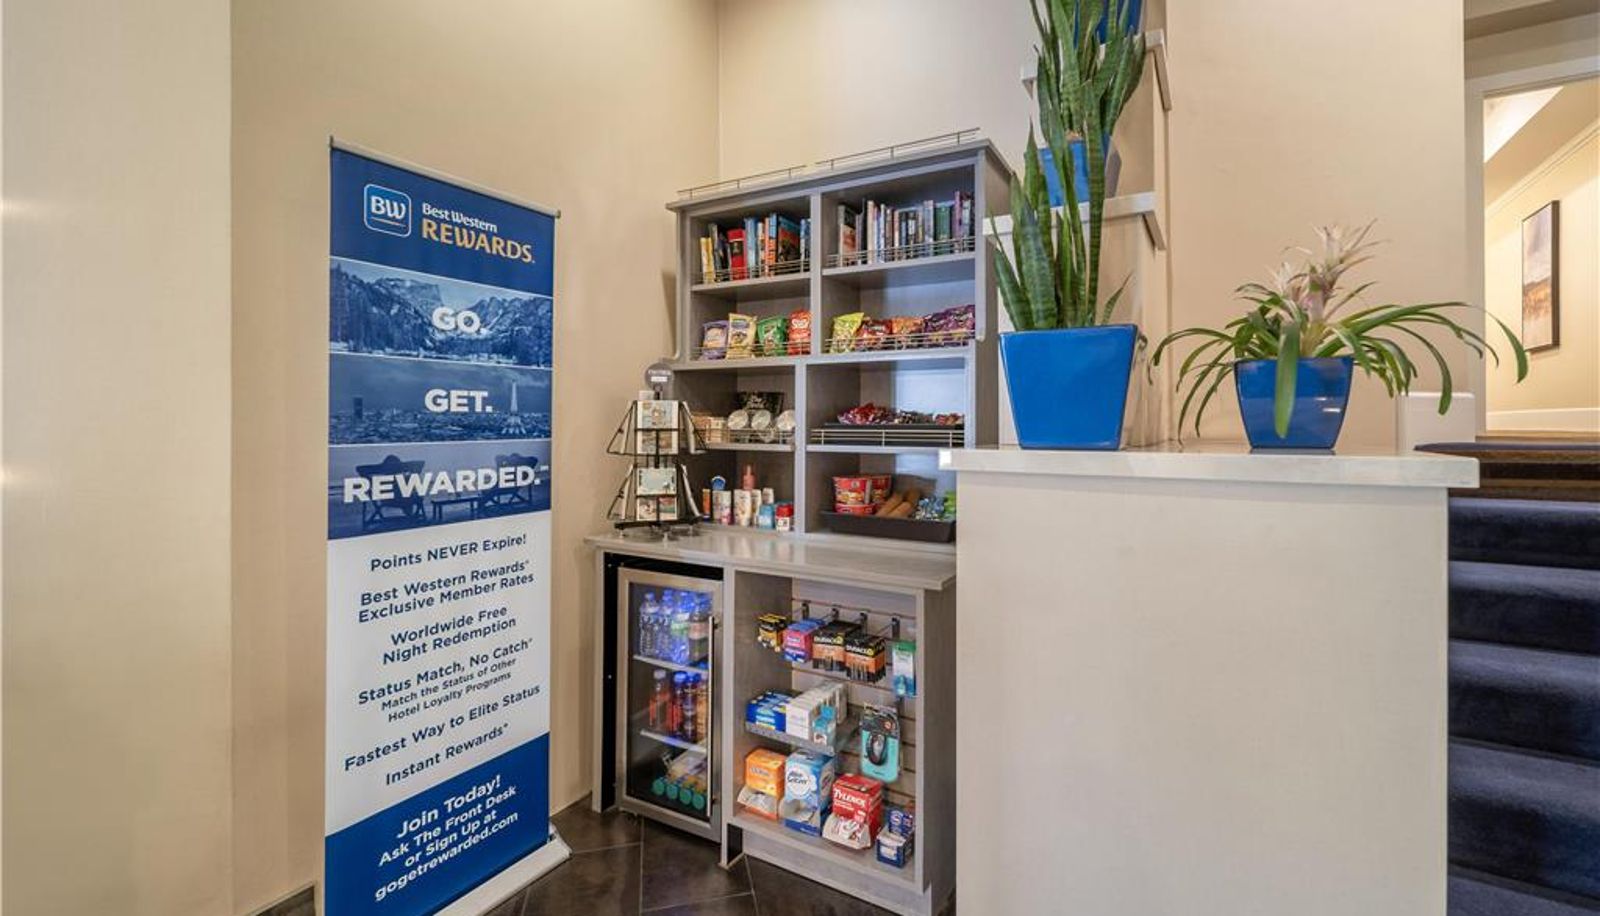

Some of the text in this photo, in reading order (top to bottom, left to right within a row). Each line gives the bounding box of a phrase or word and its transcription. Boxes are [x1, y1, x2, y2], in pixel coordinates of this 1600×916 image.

[370, 196, 406, 219] BW
[422, 203, 498, 233] Best Western
[431, 306, 487, 334] GO.
[424, 389, 493, 413] GET.
[371, 533, 527, 572] Points NEVER Expire!
[358, 572, 534, 623] Exclusive Member Rates
[361, 588, 403, 606] Best
[404, 574, 466, 597] Western
[382, 617, 516, 666] Night Redemption
[390, 607, 508, 646] Worldwide Free
[358, 678, 412, 705] Status
[416, 661, 465, 686] Match,
[470, 654, 489, 668] No
[381, 657, 516, 711] Match the Status of Other
[388, 672, 512, 722] Hotel Loyalty Programs
[343, 684, 541, 772] Fastest Way to Elite Status
[385, 753, 441, 785] Instant
[378, 786, 517, 867] Ask The Front Desk
[396, 774, 502, 839] Join Today!
[374, 812, 519, 902] gogetrewarded.com
[404, 810, 497, 868] or Sign Up at
